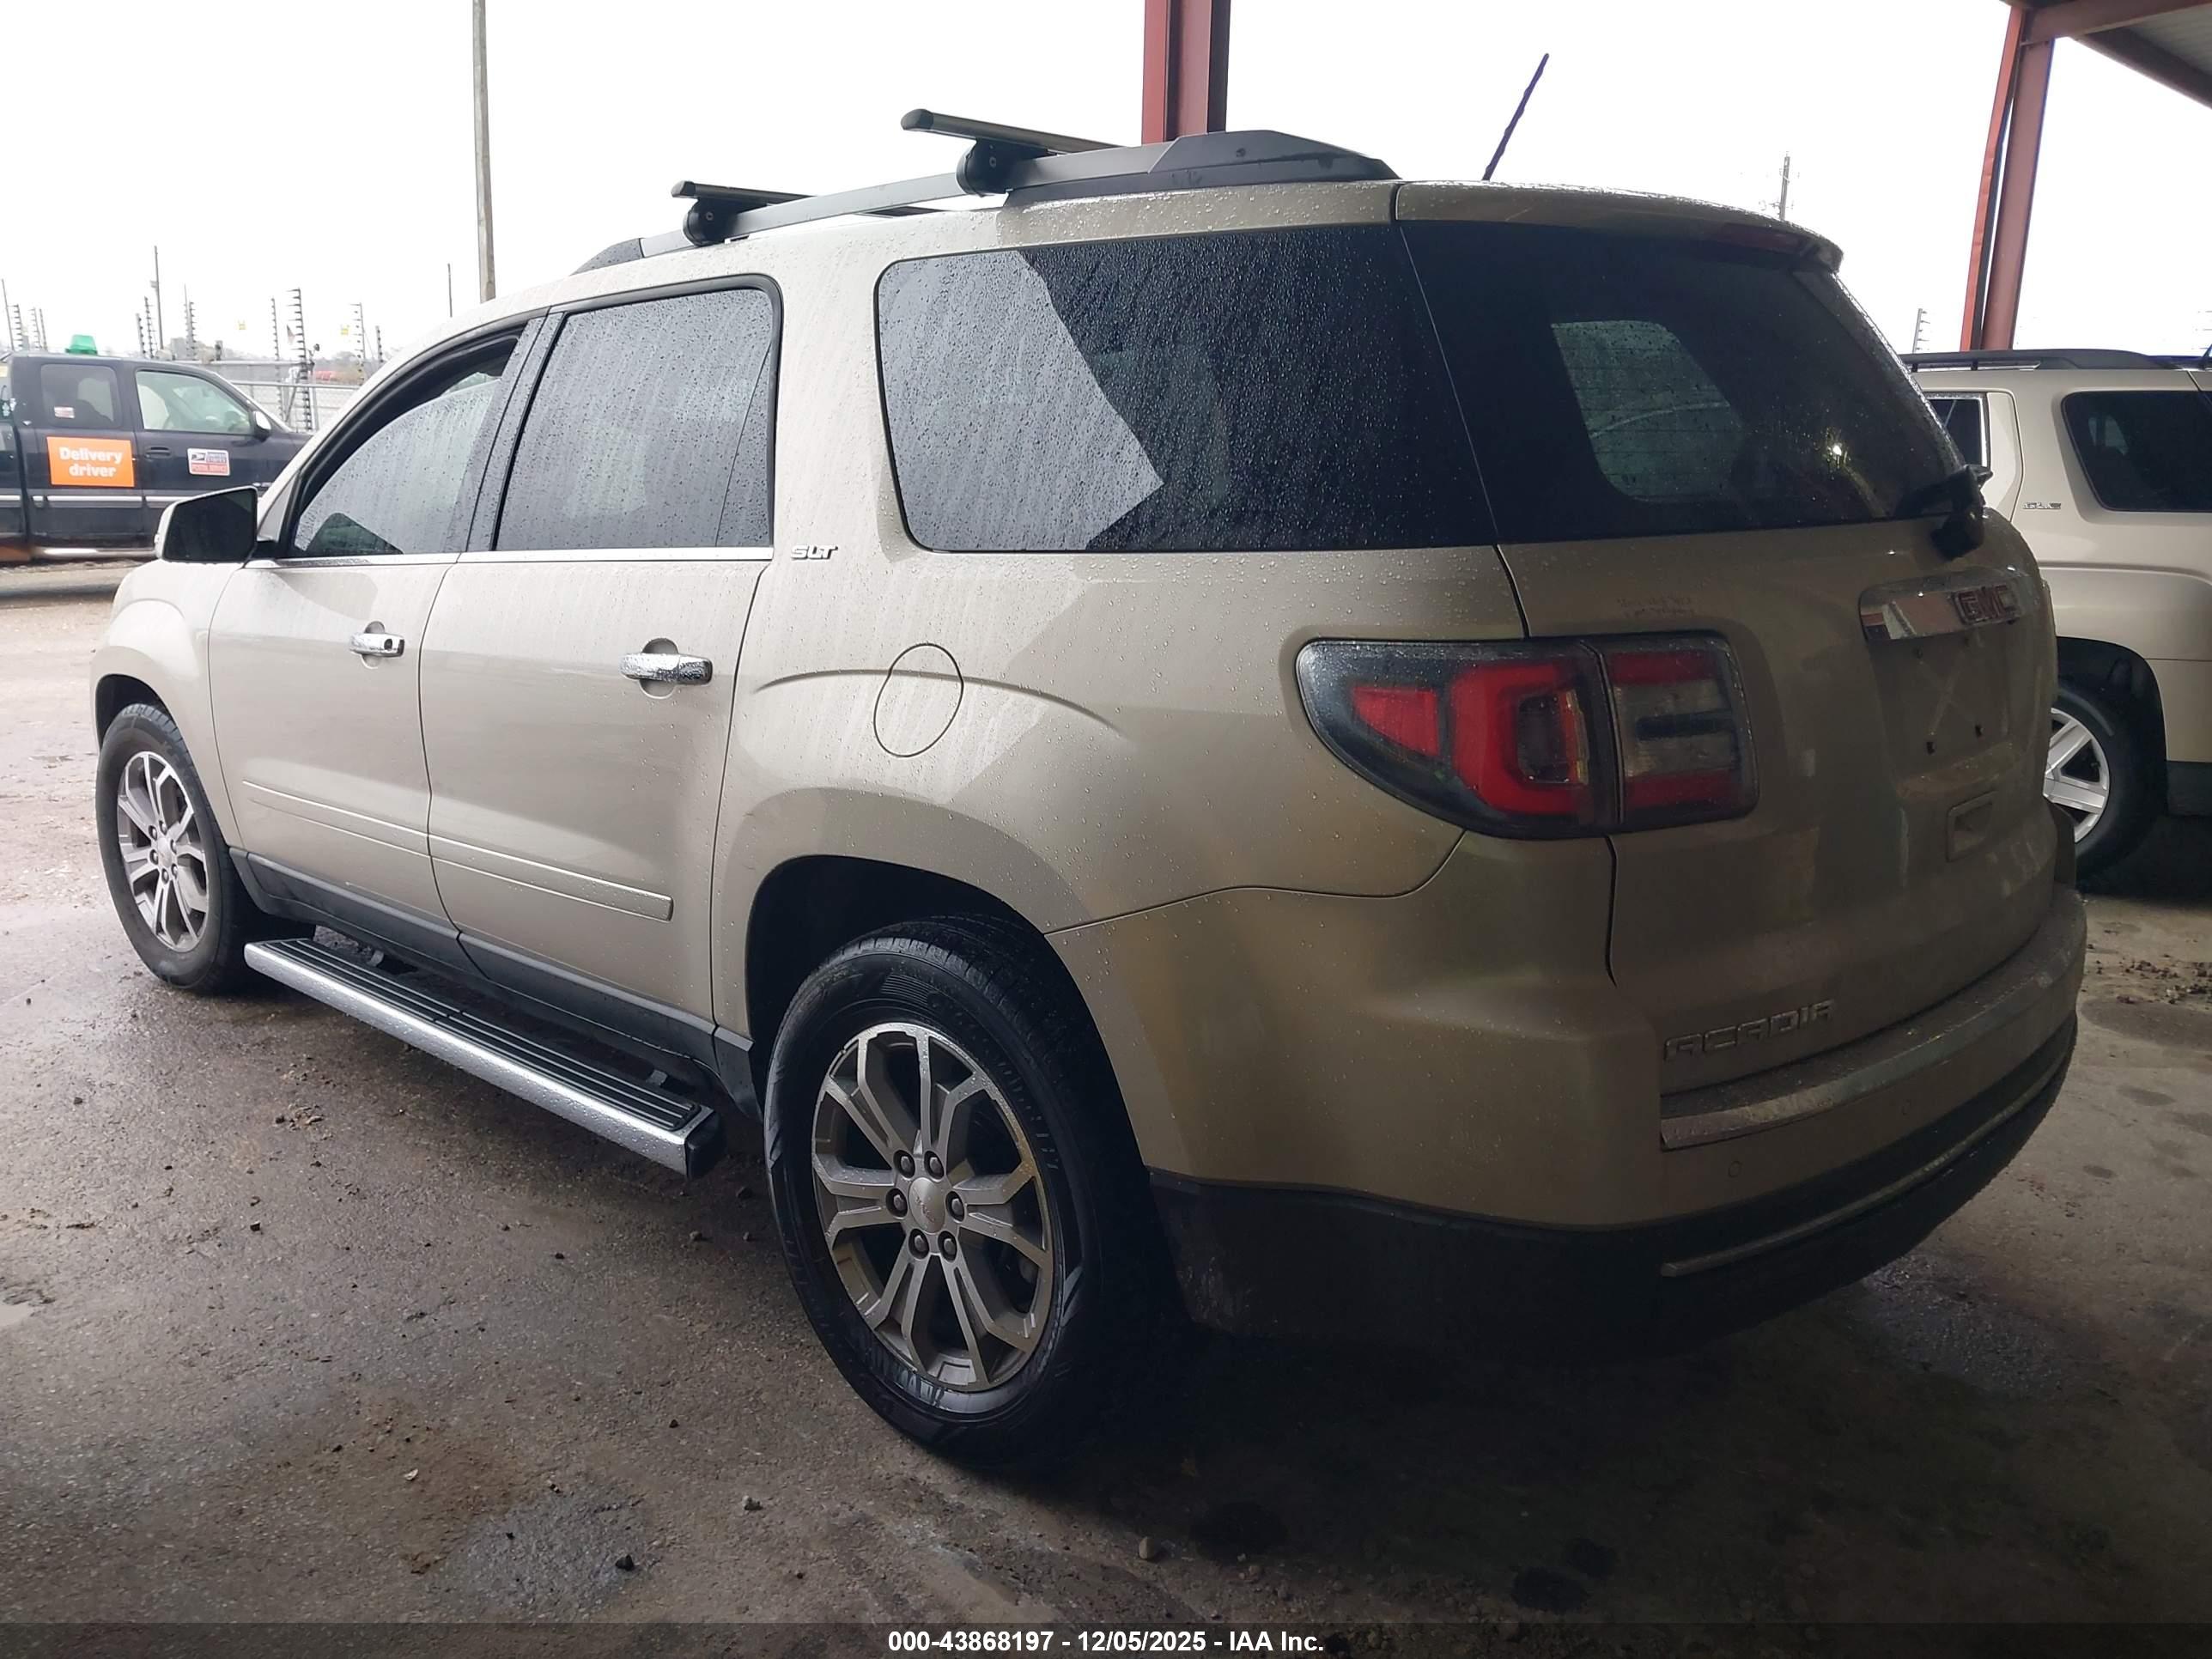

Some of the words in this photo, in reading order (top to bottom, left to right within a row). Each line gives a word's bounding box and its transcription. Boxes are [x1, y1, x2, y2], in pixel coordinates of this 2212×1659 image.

[58, 447, 123, 465] Delivery
[69, 463, 117, 478] driver
[792, 544, 838, 560] SLT
[1955, 585, 2014, 623] GMC
[1664, 1000, 1835, 1061] ACADIA
